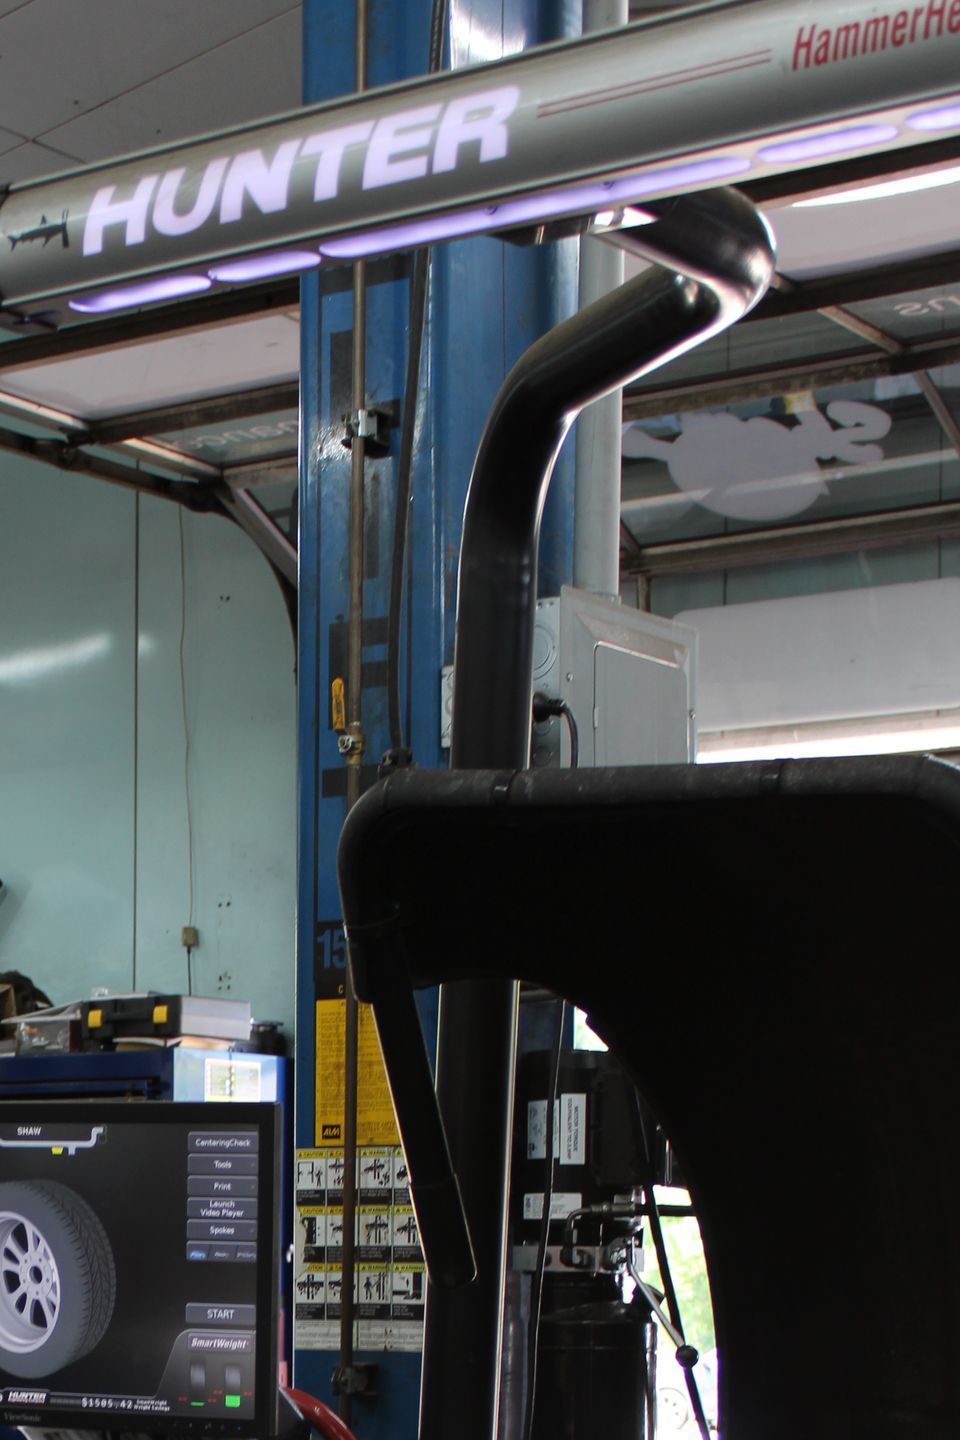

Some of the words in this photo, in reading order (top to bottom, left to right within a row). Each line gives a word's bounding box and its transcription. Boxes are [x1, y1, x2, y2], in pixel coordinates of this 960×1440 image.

[82, 85, 520, 257] HUNTER
[17, 1127, 41, 1136] SHAW
[195, 1138, 251, 1149] CenteringCheck
[213, 1160, 232, 1169] Tools
[213, 1182, 232, 1191] Print
[209, 1200, 235, 1209] Launch
[200, 1208, 220, 1217] Video
[221, 1209, 244, 1219] Player
[209, 1225, 235, 1236] Spokes
[206, 1308, 235, 1320] START
[191, 1337, 248, 1351] SmartWeight
[7, 1391, 47, 1404] HUNTER
